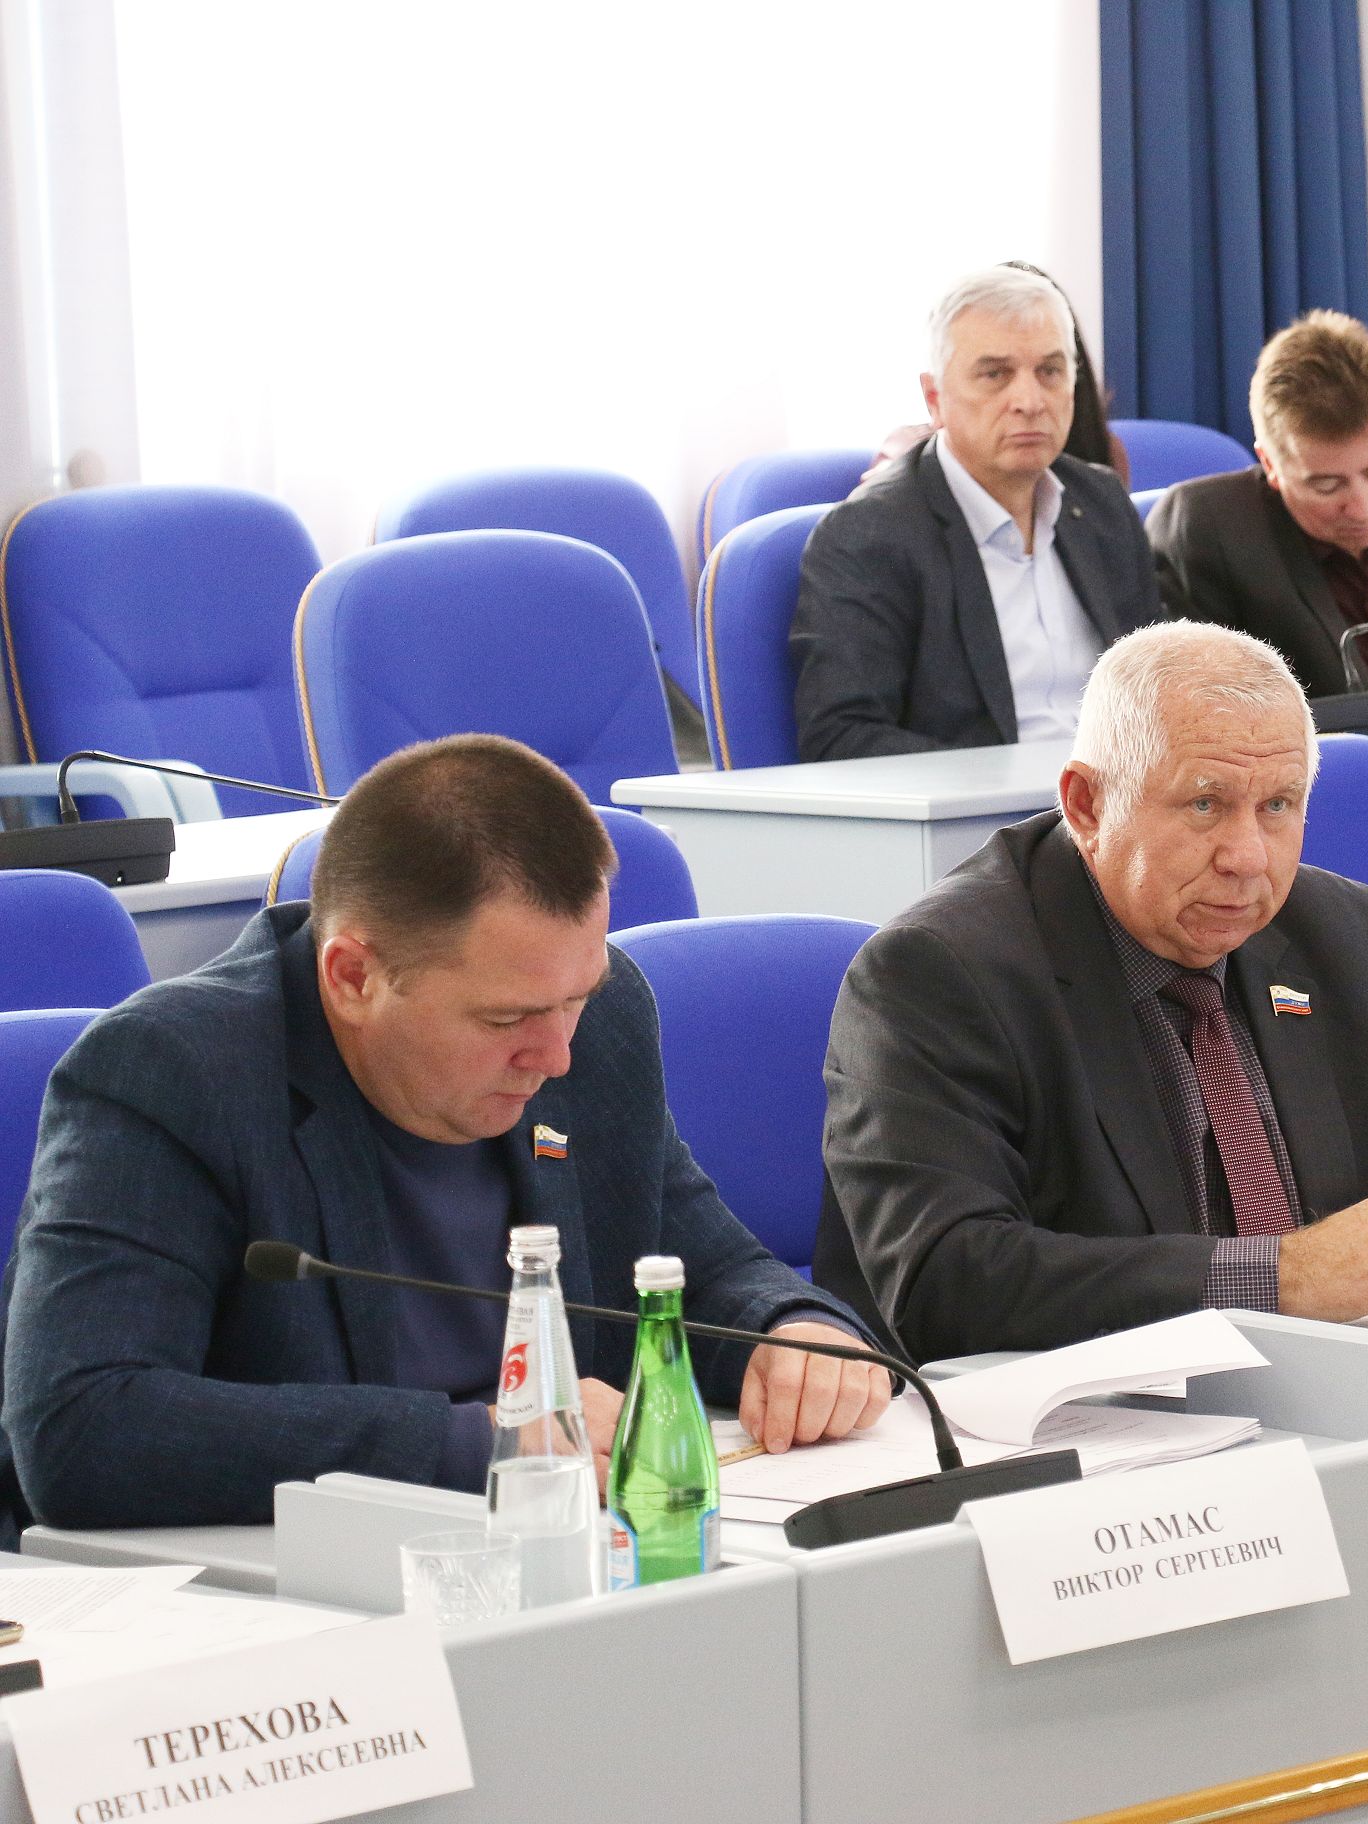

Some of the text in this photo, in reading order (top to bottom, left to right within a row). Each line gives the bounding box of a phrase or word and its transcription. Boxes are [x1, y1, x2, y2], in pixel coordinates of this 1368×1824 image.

[1094, 1506, 1224, 1555] ОТАМАС
[1052, 1536, 1284, 1601] ВИКТОР СЕРГЕЕВИЧ
[135, 1696, 349, 1768] ТЕРЕХОВА
[75, 1728, 427, 1824] СВЕТЛАНА АЛЕКСЕЕВНА
